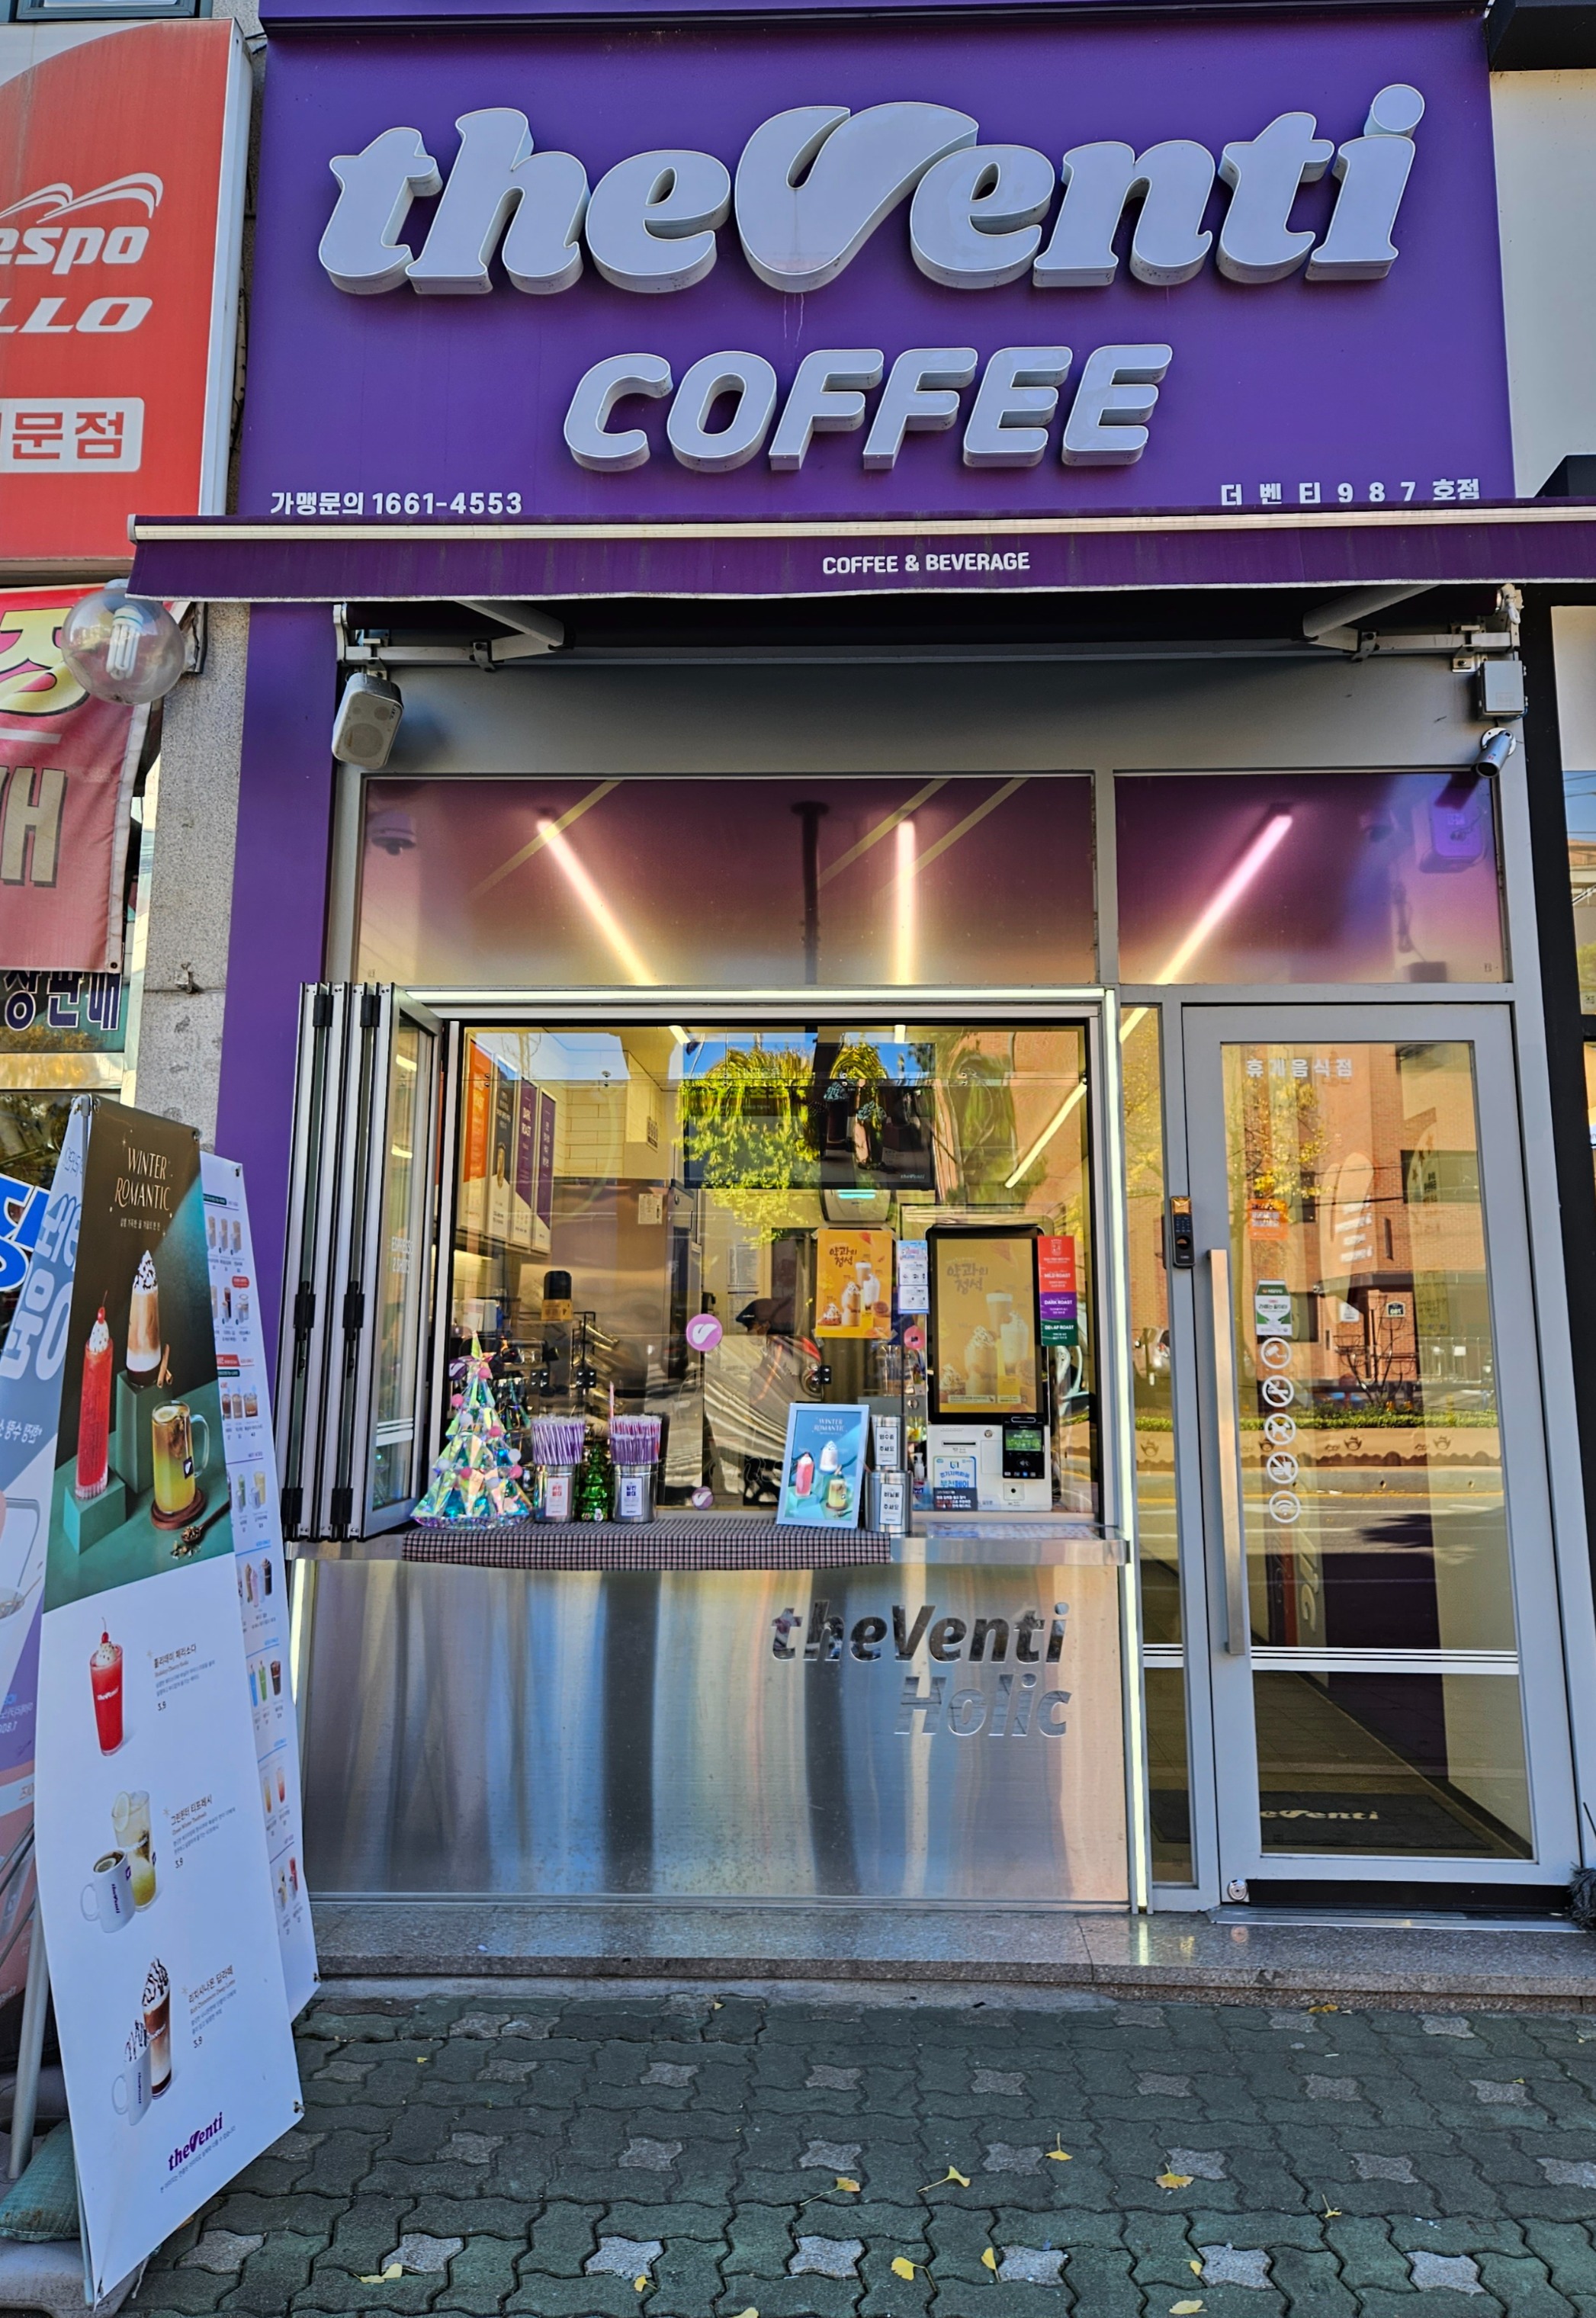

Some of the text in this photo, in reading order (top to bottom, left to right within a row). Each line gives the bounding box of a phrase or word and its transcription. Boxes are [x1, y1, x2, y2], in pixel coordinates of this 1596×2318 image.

[319, 84, 1425, 296] theVenti
[0, 411, 124, 460] 문점
[564, 343, 1174, 473] COFFEE
[270, 492, 522, 515] 가맹문의 1661-4553
[823, 552, 1030, 574] COFFEE & BEVERAGE
[128, 1146, 167, 1180] WINTER
[114, 1177, 171, 1211] ROMANTIC
[771, 1600, 1070, 1665] theVenti
[894, 1673, 1072, 1738] Holic
[168, 2111, 223, 2172] theVenti
